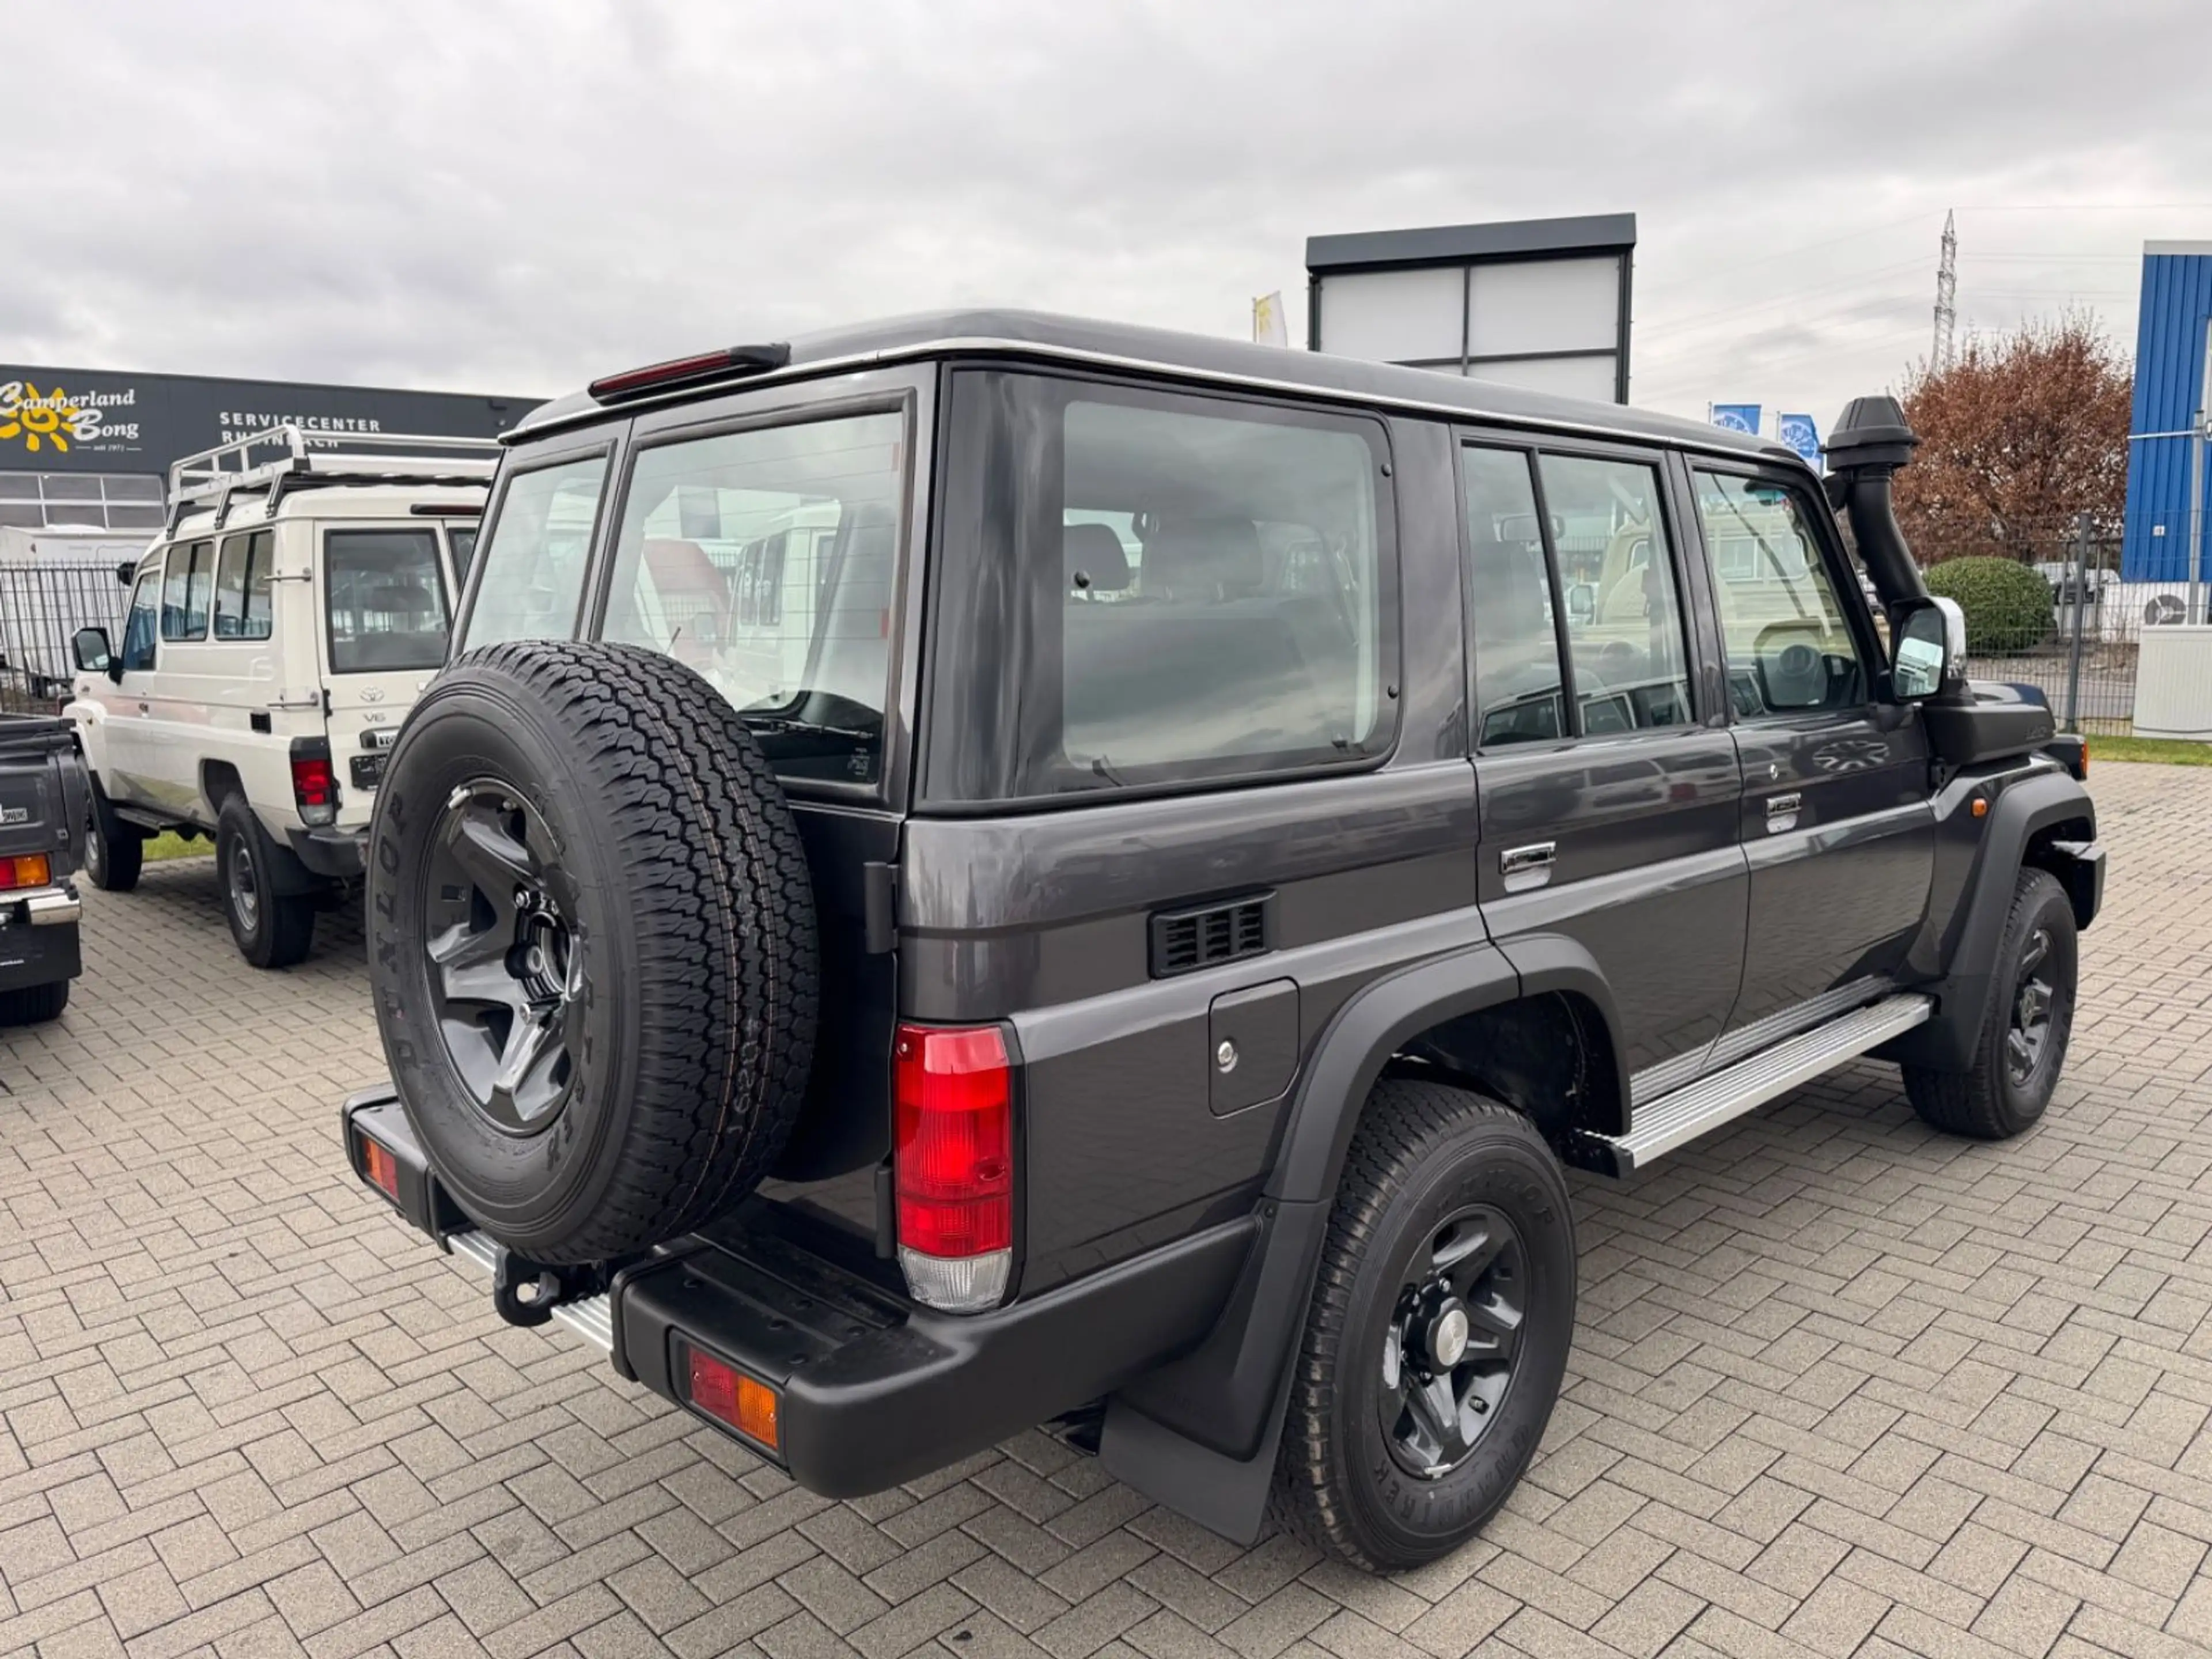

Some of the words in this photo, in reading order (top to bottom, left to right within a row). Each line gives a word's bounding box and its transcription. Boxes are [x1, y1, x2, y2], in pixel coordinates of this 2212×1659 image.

[67, 408, 139, 441] Bong
[219, 411, 381, 432] SERVICECENTER
[363, 711, 386, 722] V6
